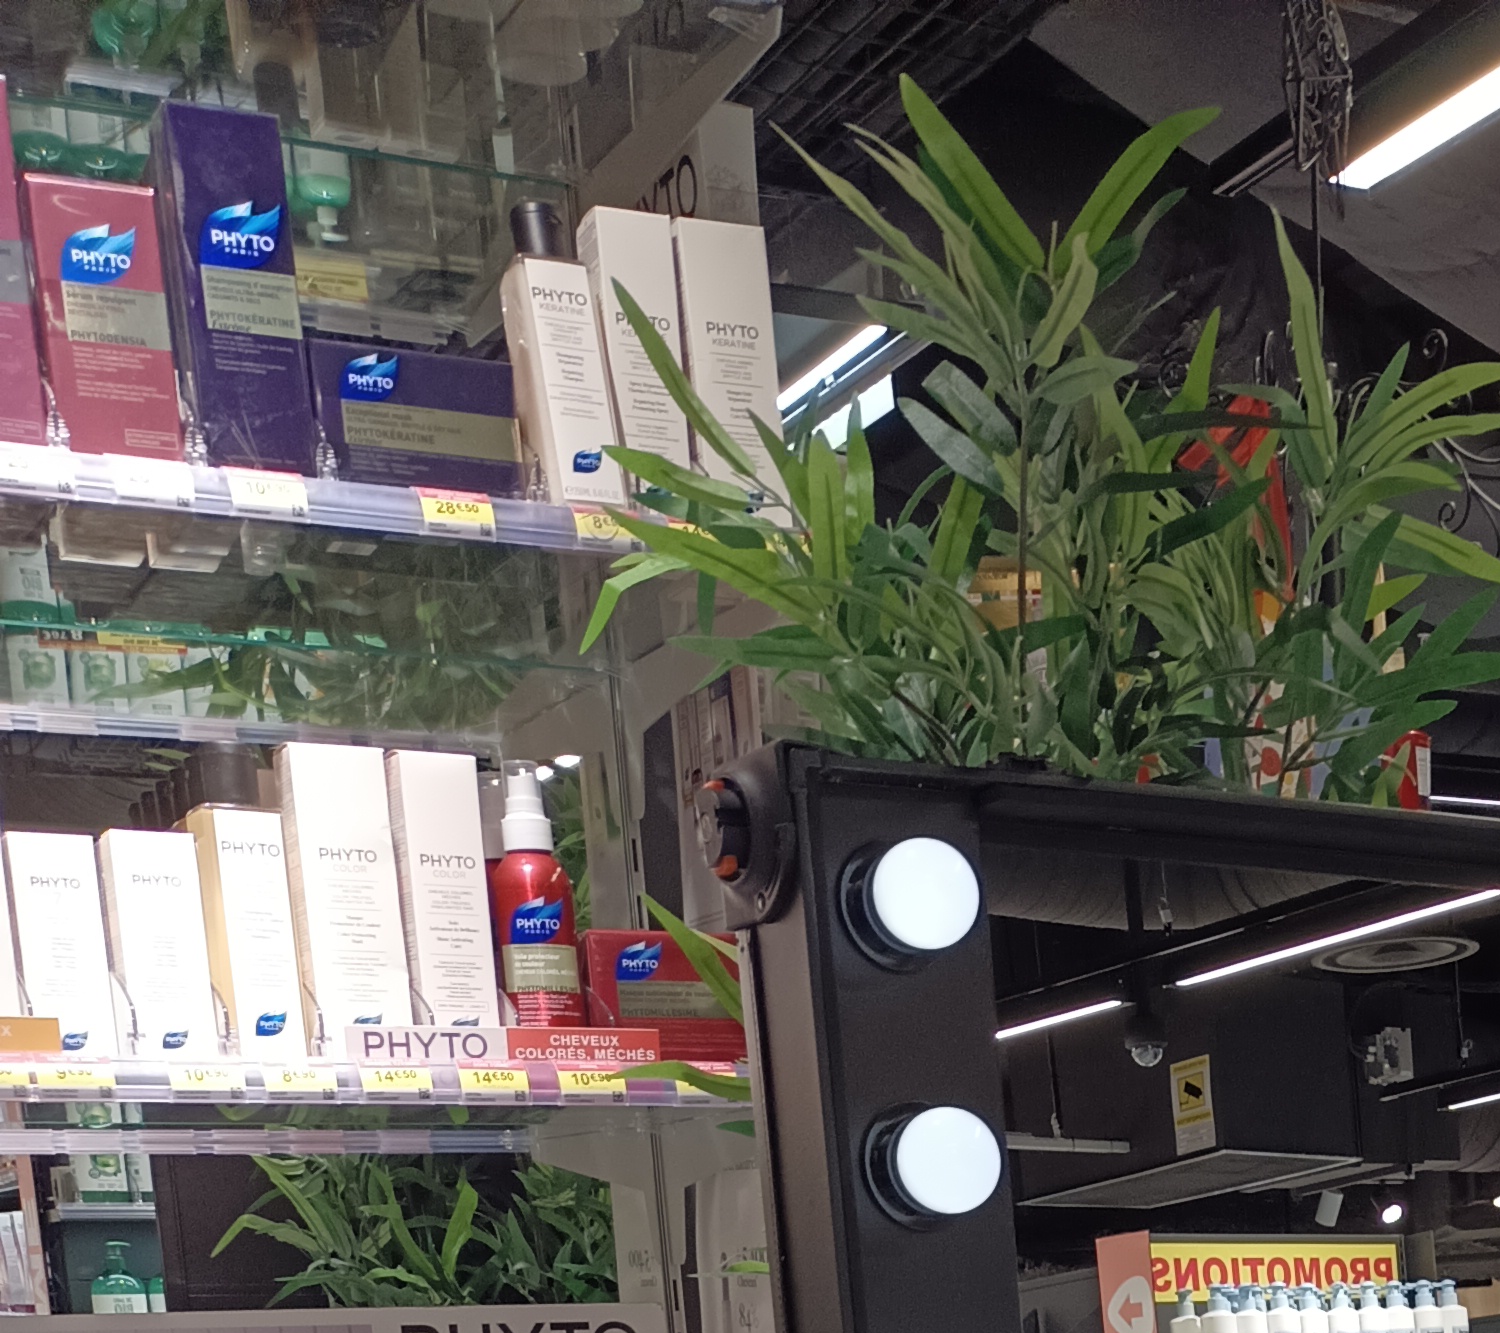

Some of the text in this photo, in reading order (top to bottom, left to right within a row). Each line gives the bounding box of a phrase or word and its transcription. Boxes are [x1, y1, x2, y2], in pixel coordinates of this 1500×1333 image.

[210, 227, 275, 252] PHYTO
[70, 248, 131, 270] PHYTO
[531, 285, 588, 307] PHYTO
[538, 301, 586, 317] KERATINE
[615, 311, 671, 332] PTO
[70, 328, 148, 348] PHYTODENSIA
[705, 320, 760, 340] PHYTO
[711, 337, 757, 351] KERATINE
[348, 372, 394, 390] PHYTO
[435, 500, 480, 516] 28€50
[220, 840, 281, 858] PHYTO
[318, 847, 378, 863] PHYTO
[419, 853, 477, 870] PHYTO
[30, 875, 81, 890] PHYTO
[131, 873, 182, 888] PHYTO
[432, 869, 467, 880] COLOR
[516, 918, 560, 931] PHYTO
[621, 957, 659, 969] PHYTO
[363, 1030, 488, 1059] PHYTO
[549, 1033, 620, 1047] CHEVEUX
[515, 1045, 656, 1062] COLORÉS, MÉCHÉS
[374, 1069, 417, 1083] 14€50
[472, 1070, 515, 1085] 14€50
